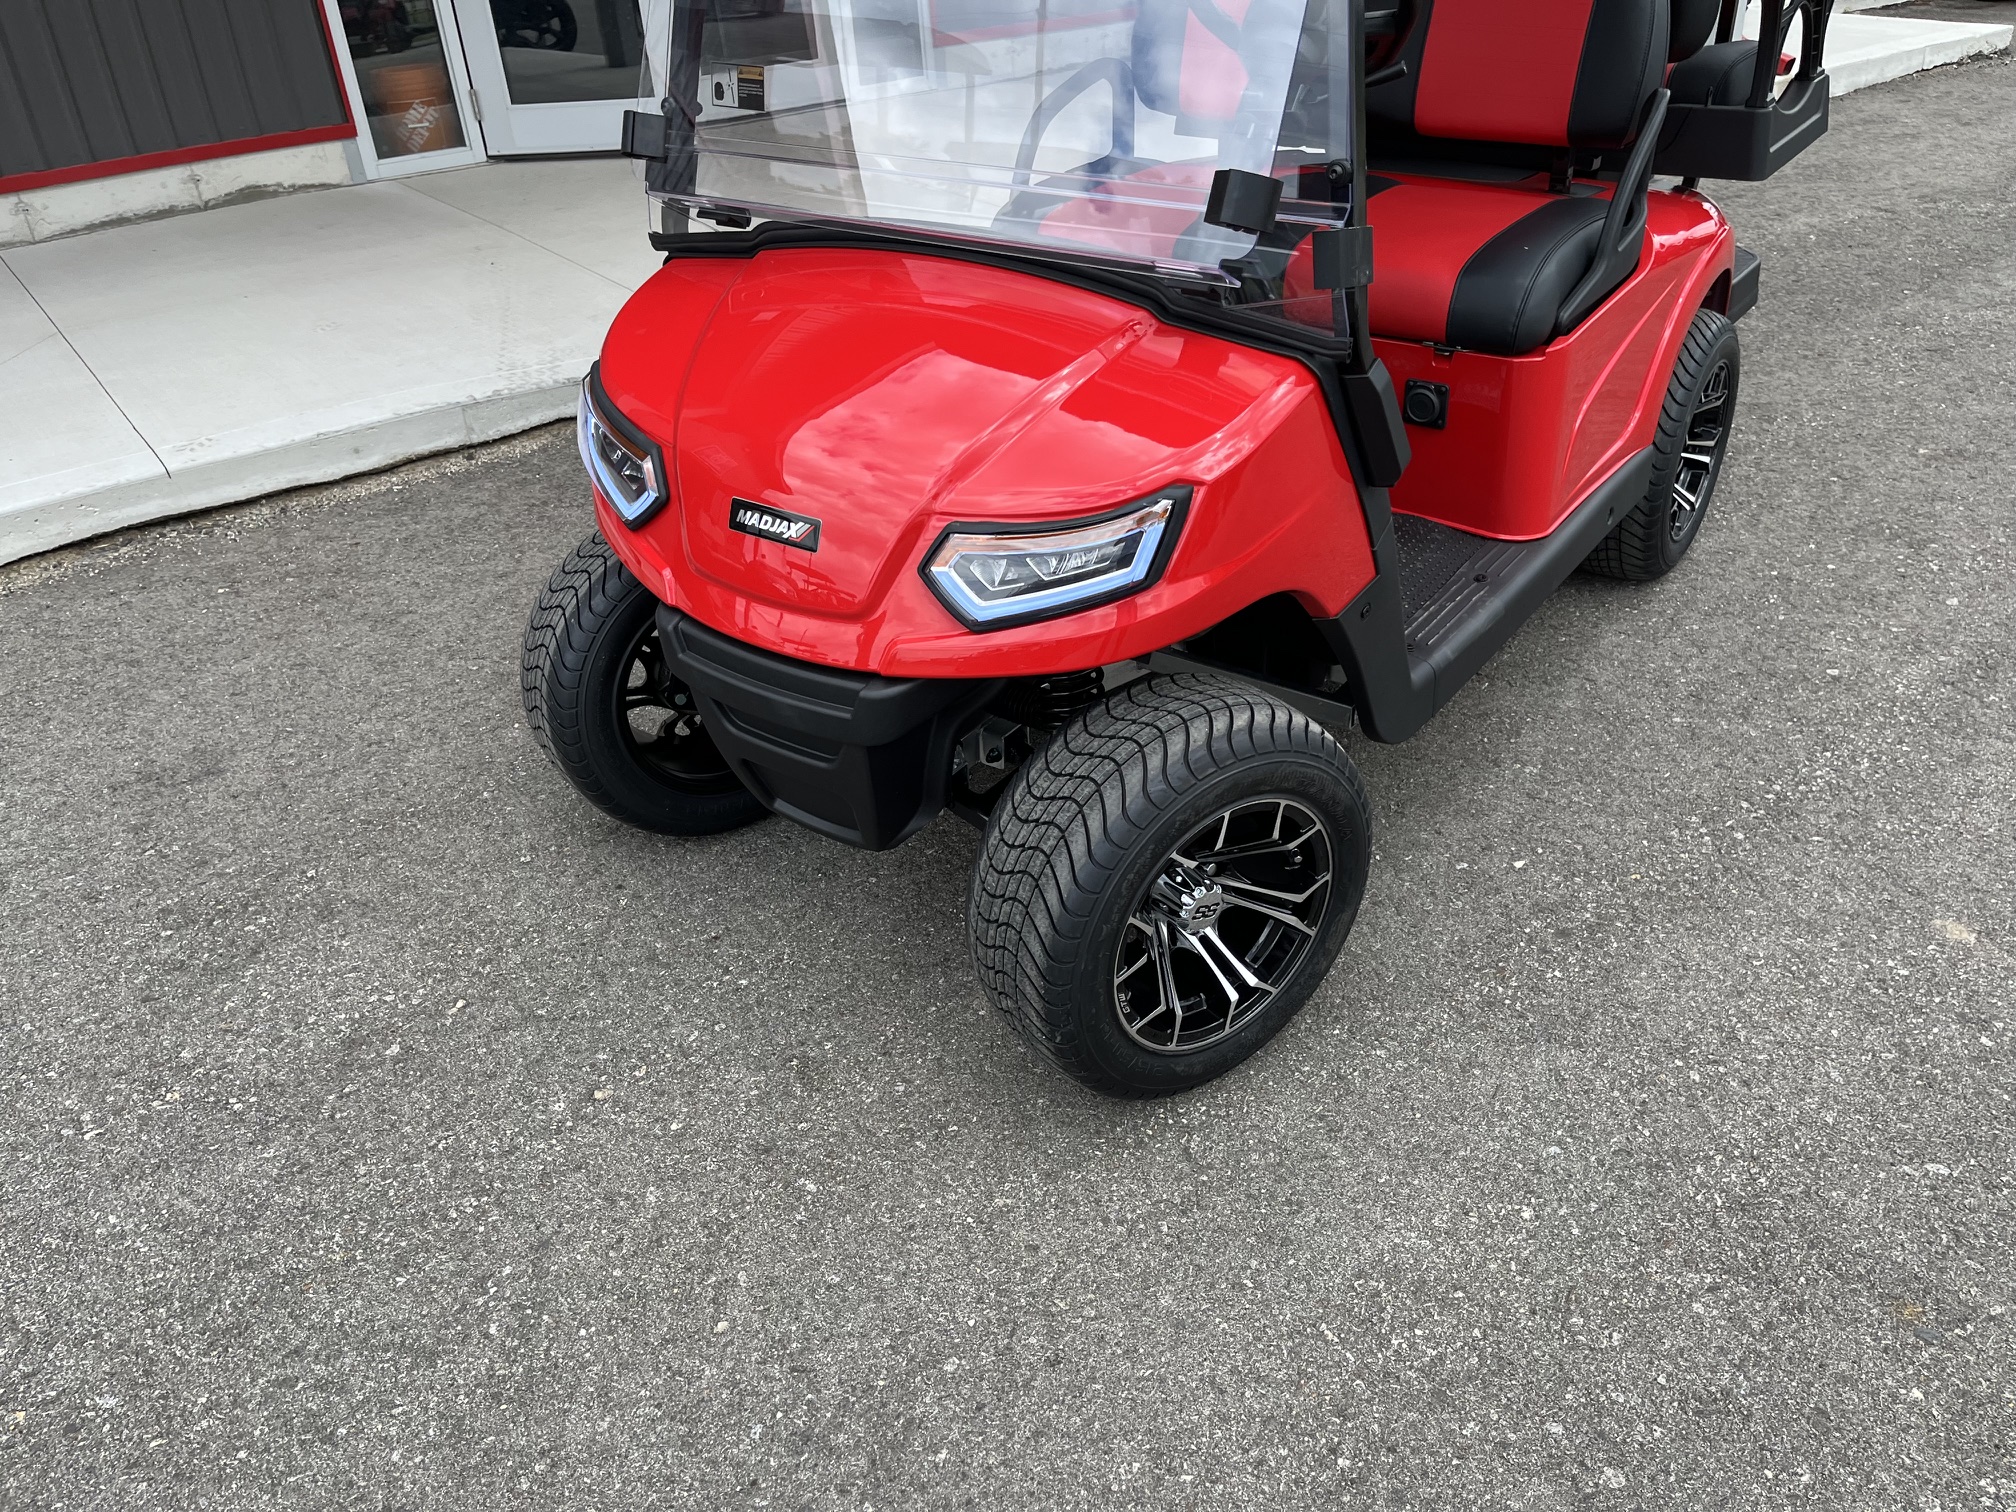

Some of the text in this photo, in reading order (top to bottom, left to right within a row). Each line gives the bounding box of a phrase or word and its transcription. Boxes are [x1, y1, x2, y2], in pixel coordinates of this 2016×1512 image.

[396, 100, 428, 141] HOME
[406, 106, 440, 152] DEPOT
[735, 509, 806, 539] MADJAX
[1117, 992, 1131, 1014] GTW
